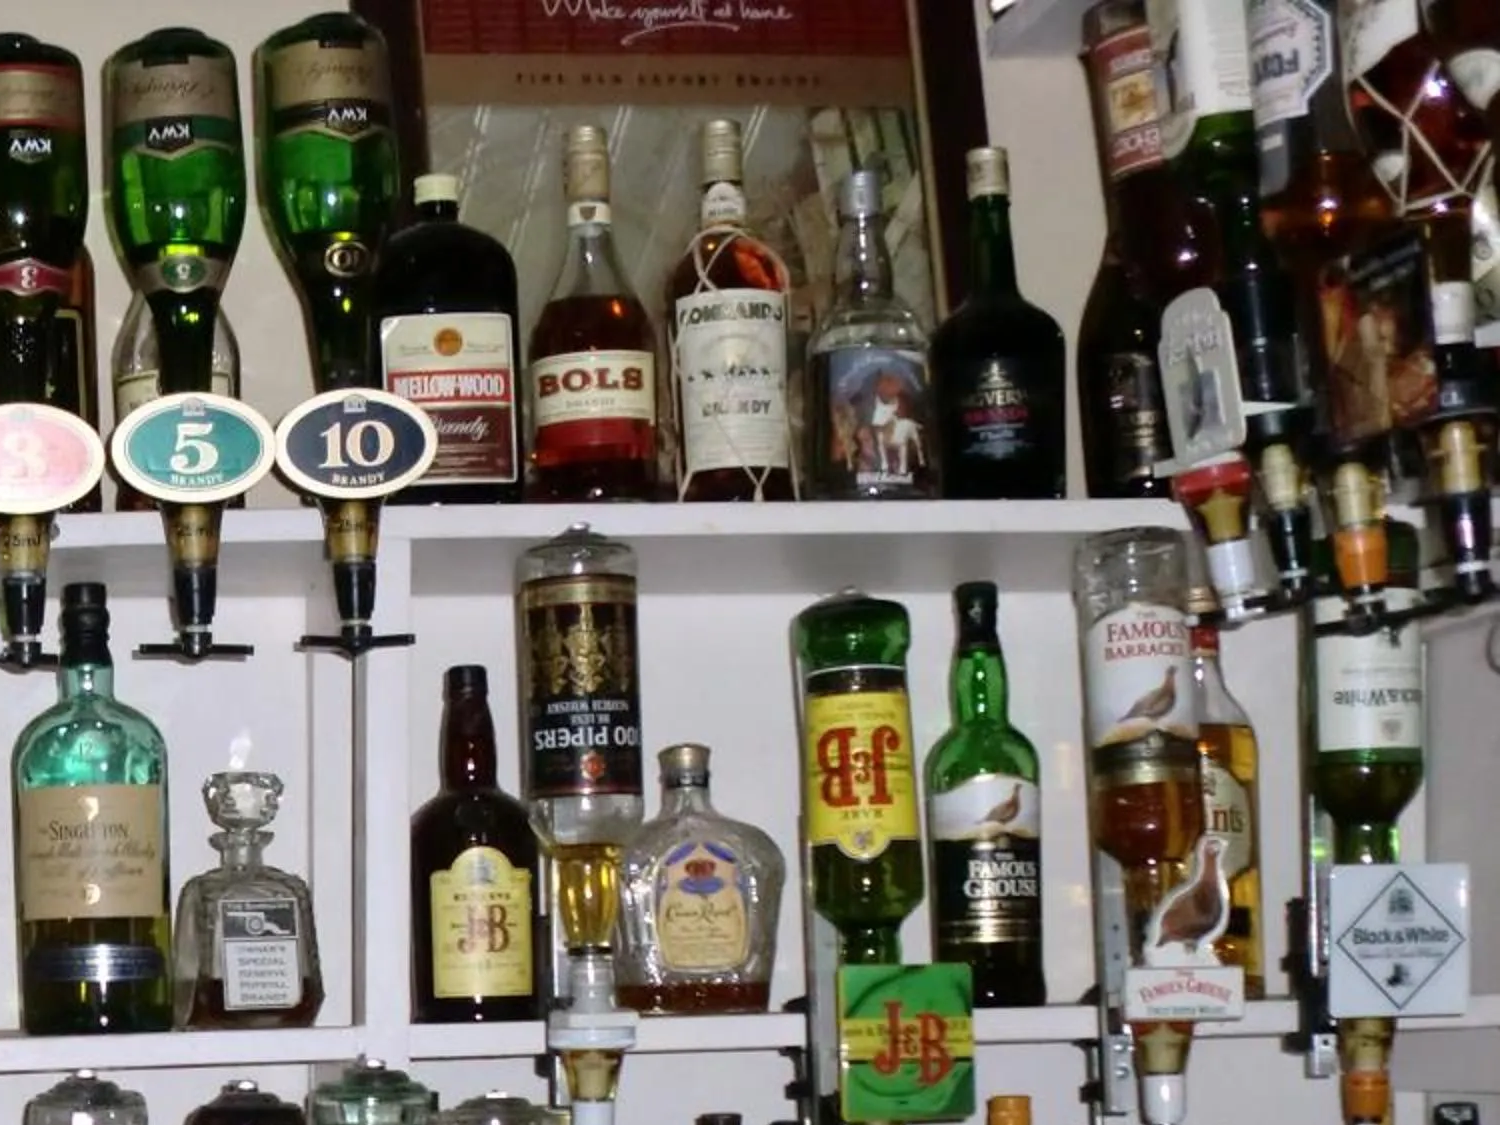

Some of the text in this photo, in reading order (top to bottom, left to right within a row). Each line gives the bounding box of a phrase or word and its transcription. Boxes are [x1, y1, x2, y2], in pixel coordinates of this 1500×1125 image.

[328, 107, 367, 122] KWV
[148, 124, 190, 142] KWV
[8, 138, 51, 154] KWV
[538, 368, 644, 397] BOLS
[170, 421, 220, 475] 5
[319, 419, 395, 469] 10
[171, 473, 224, 486] BRANDY
[332, 472, 386, 486] BRANDY
[534, 726, 609, 751] PIPERS
[967, 860, 1037, 879] FAMOUS
